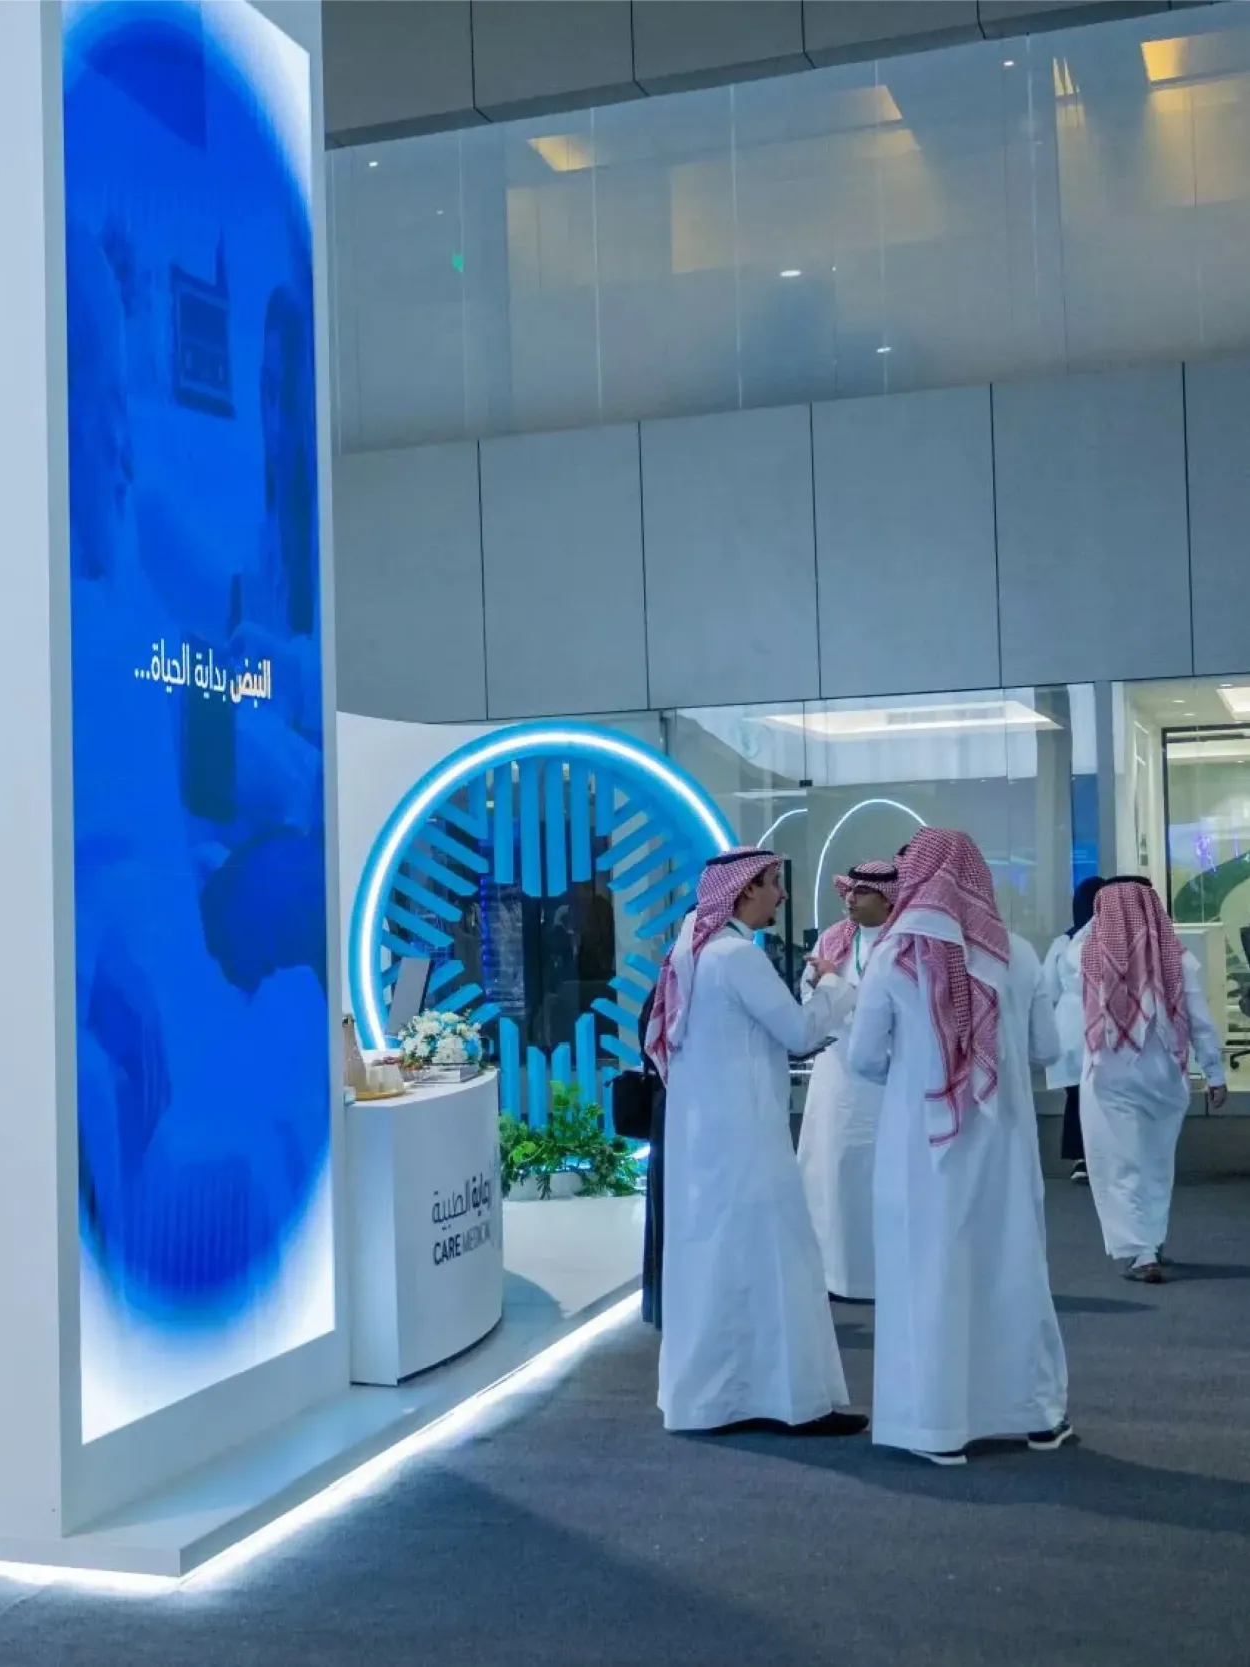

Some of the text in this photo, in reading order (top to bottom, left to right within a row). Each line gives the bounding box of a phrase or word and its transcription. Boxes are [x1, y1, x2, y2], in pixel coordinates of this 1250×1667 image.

[194, 648, 227, 702] بداية
[229, 657, 271, 709] النبض
[433, 1233, 461, 1265] CARE
